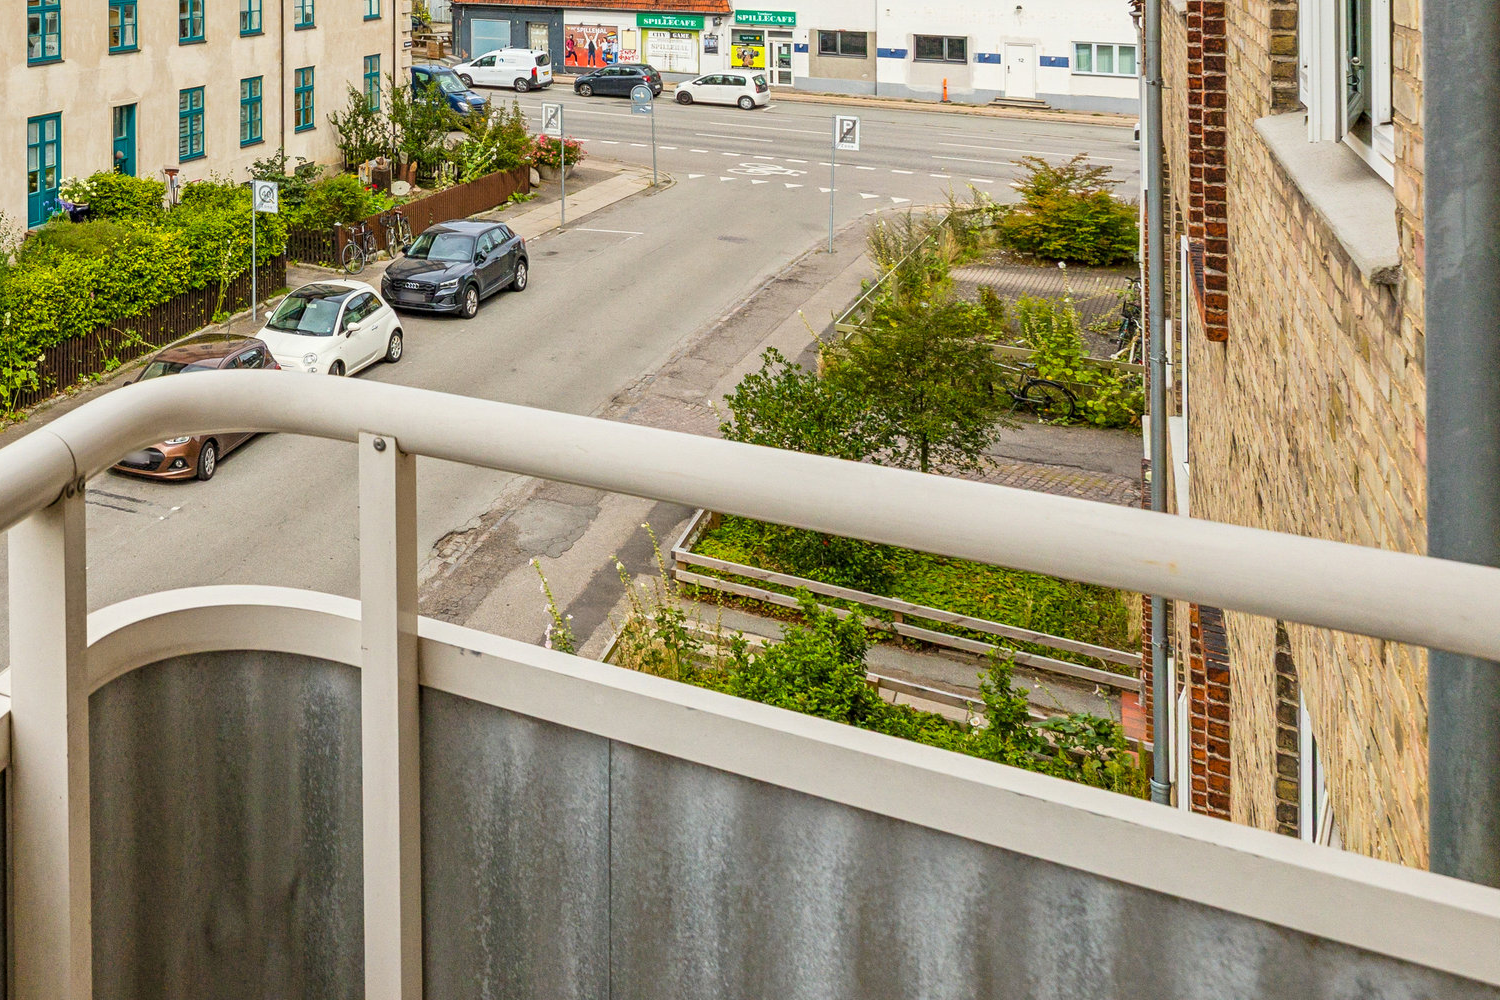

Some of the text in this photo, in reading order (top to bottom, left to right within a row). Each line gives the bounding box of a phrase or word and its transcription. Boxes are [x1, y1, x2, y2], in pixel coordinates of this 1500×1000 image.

[643, 18, 697, 27] SPILLECAFE
[736, 15, 795, 23] SPILLECAFE
[547, 107, 555, 119] P
[843, 120, 853, 133] P
